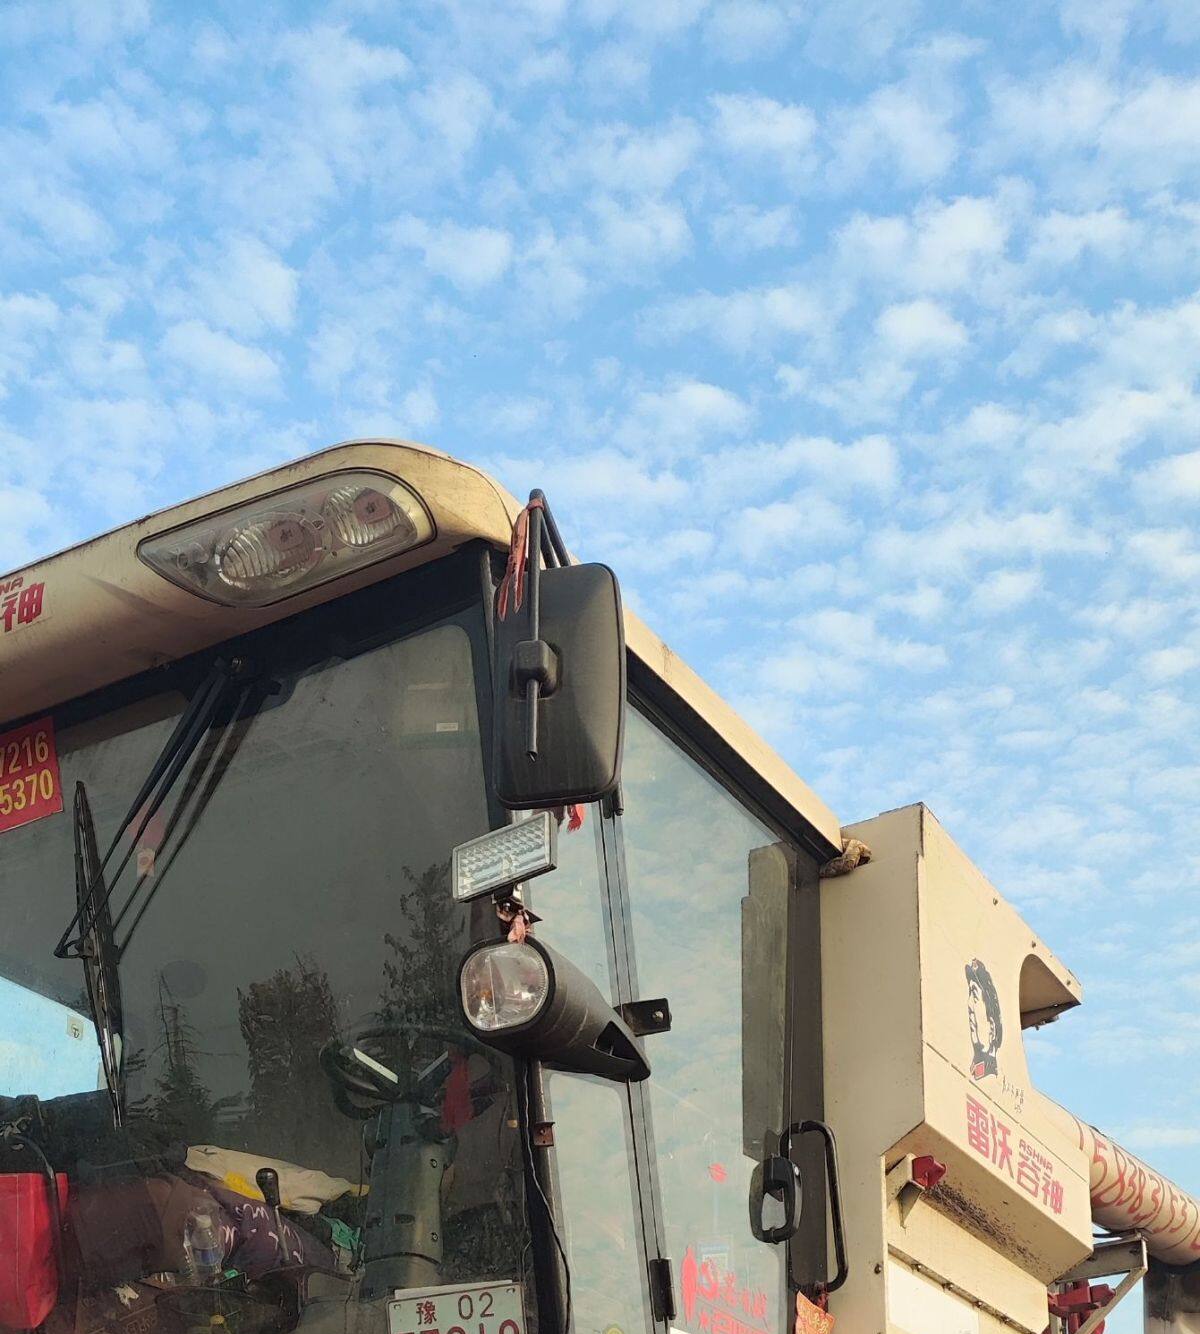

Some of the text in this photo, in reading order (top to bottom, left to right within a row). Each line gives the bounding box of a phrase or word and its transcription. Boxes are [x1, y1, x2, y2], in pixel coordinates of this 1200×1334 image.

[966, 1093, 1064, 1216] 雷沃谷神
[1018, 1138, 1054, 1174] ASHNA
[416, 1291, 495, 1326] 豫 02
